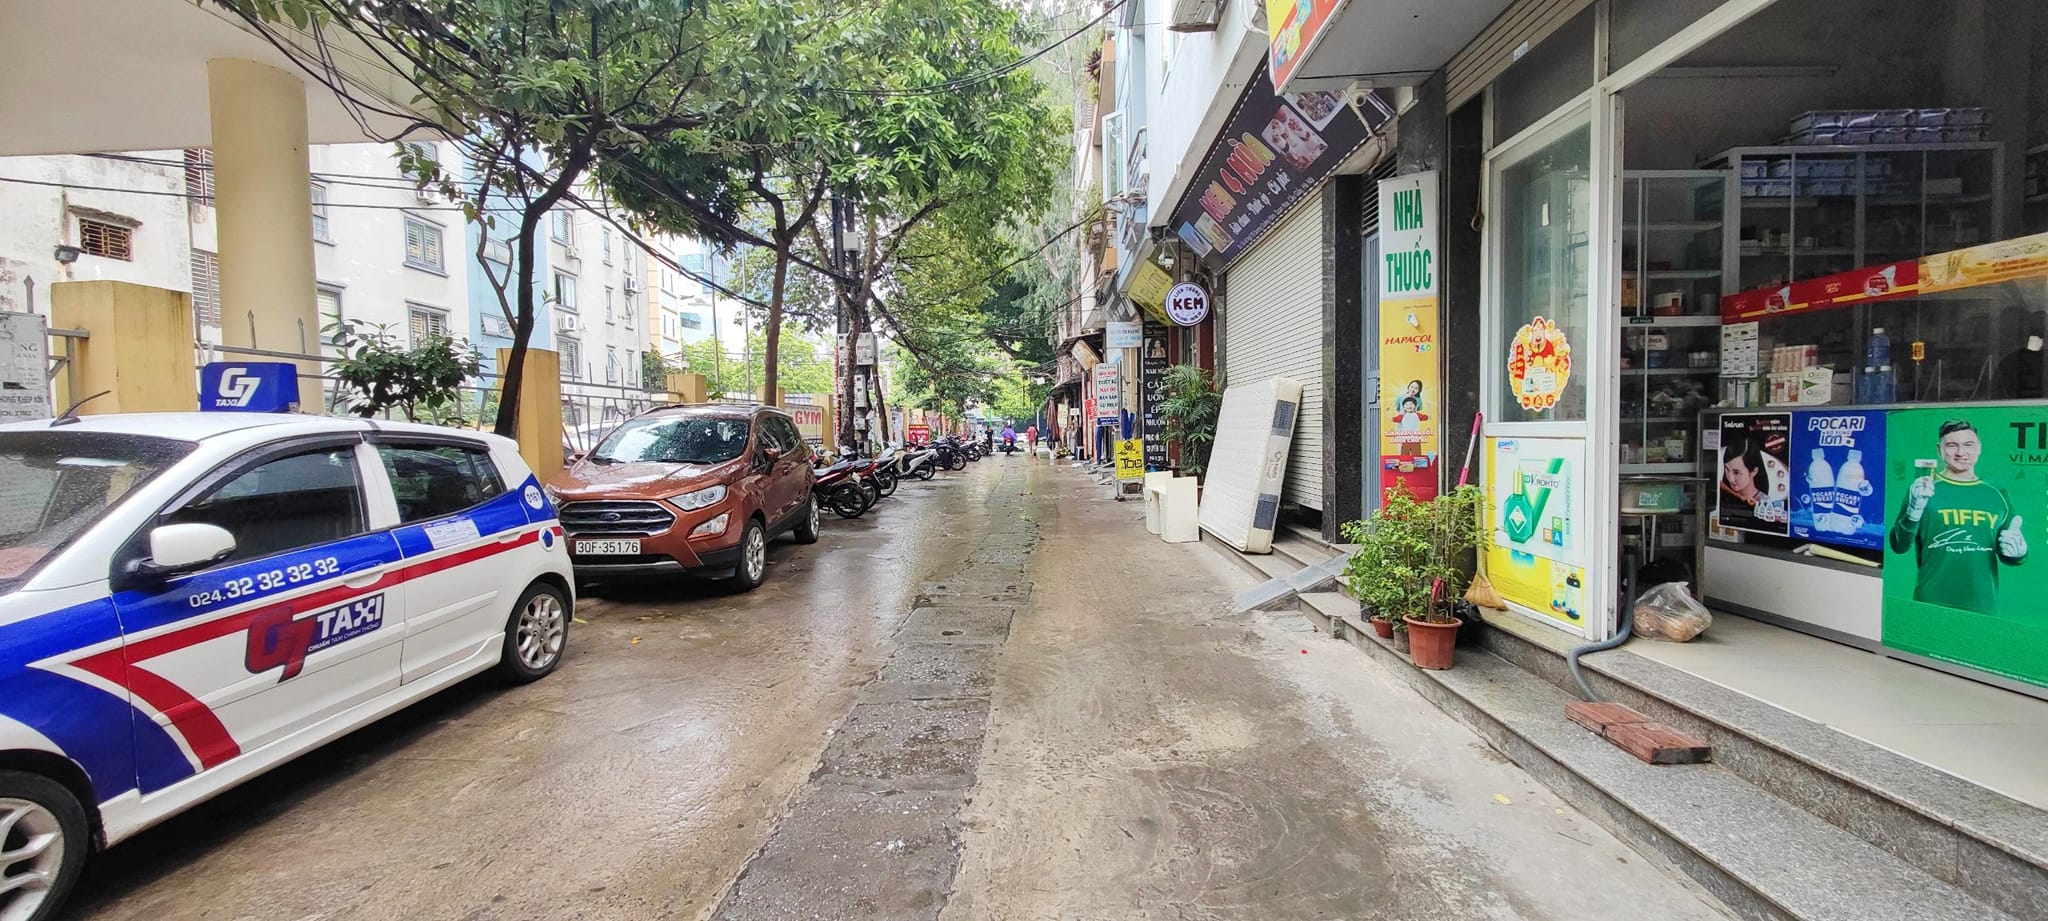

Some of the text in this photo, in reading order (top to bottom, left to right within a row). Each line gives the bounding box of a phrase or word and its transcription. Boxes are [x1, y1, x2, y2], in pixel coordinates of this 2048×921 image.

[1220, 167, 1247, 195] 4
[1386, 235, 1432, 293] THUỐC
[1173, 297, 1204, 311] KEM
[1385, 334, 1433, 345] HAPACOL
[1414, 344, 1432, 352] 250
[215, 399, 239, 407] TAXI
[794, 410, 822, 425] GYM
[1809, 417, 1865, 430] POCARI
[1937, 509, 1999, 529] TIFFY
[577, 541, 639, 553] 30F-351.76
[256, 569, 286, 591] 32
[286, 563, 314, 584] 32
[315, 557, 340, 576] 32
[317, 595, 383, 639] TAXI
